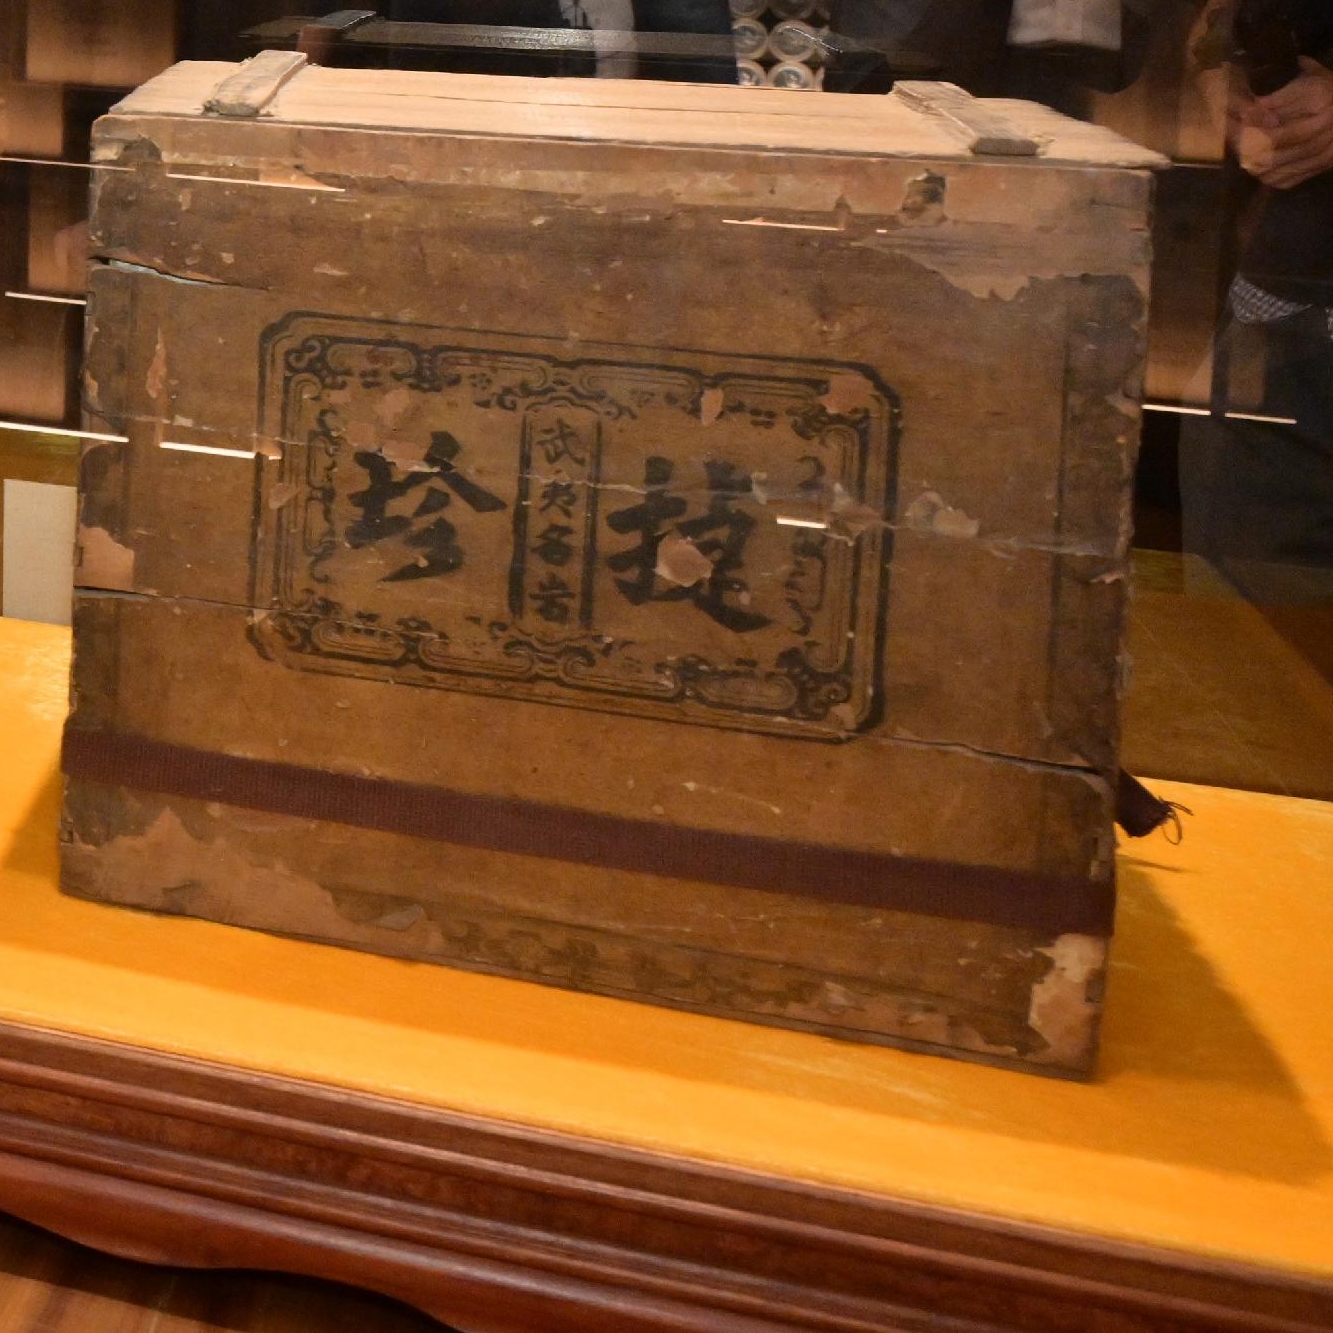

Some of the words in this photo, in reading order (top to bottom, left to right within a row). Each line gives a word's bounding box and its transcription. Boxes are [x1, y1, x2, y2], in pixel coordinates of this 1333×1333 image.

[343, 429, 508, 583] 珍
[528, 417, 587, 623] 武夷名岩
[606, 457, 773, 633] 捷
